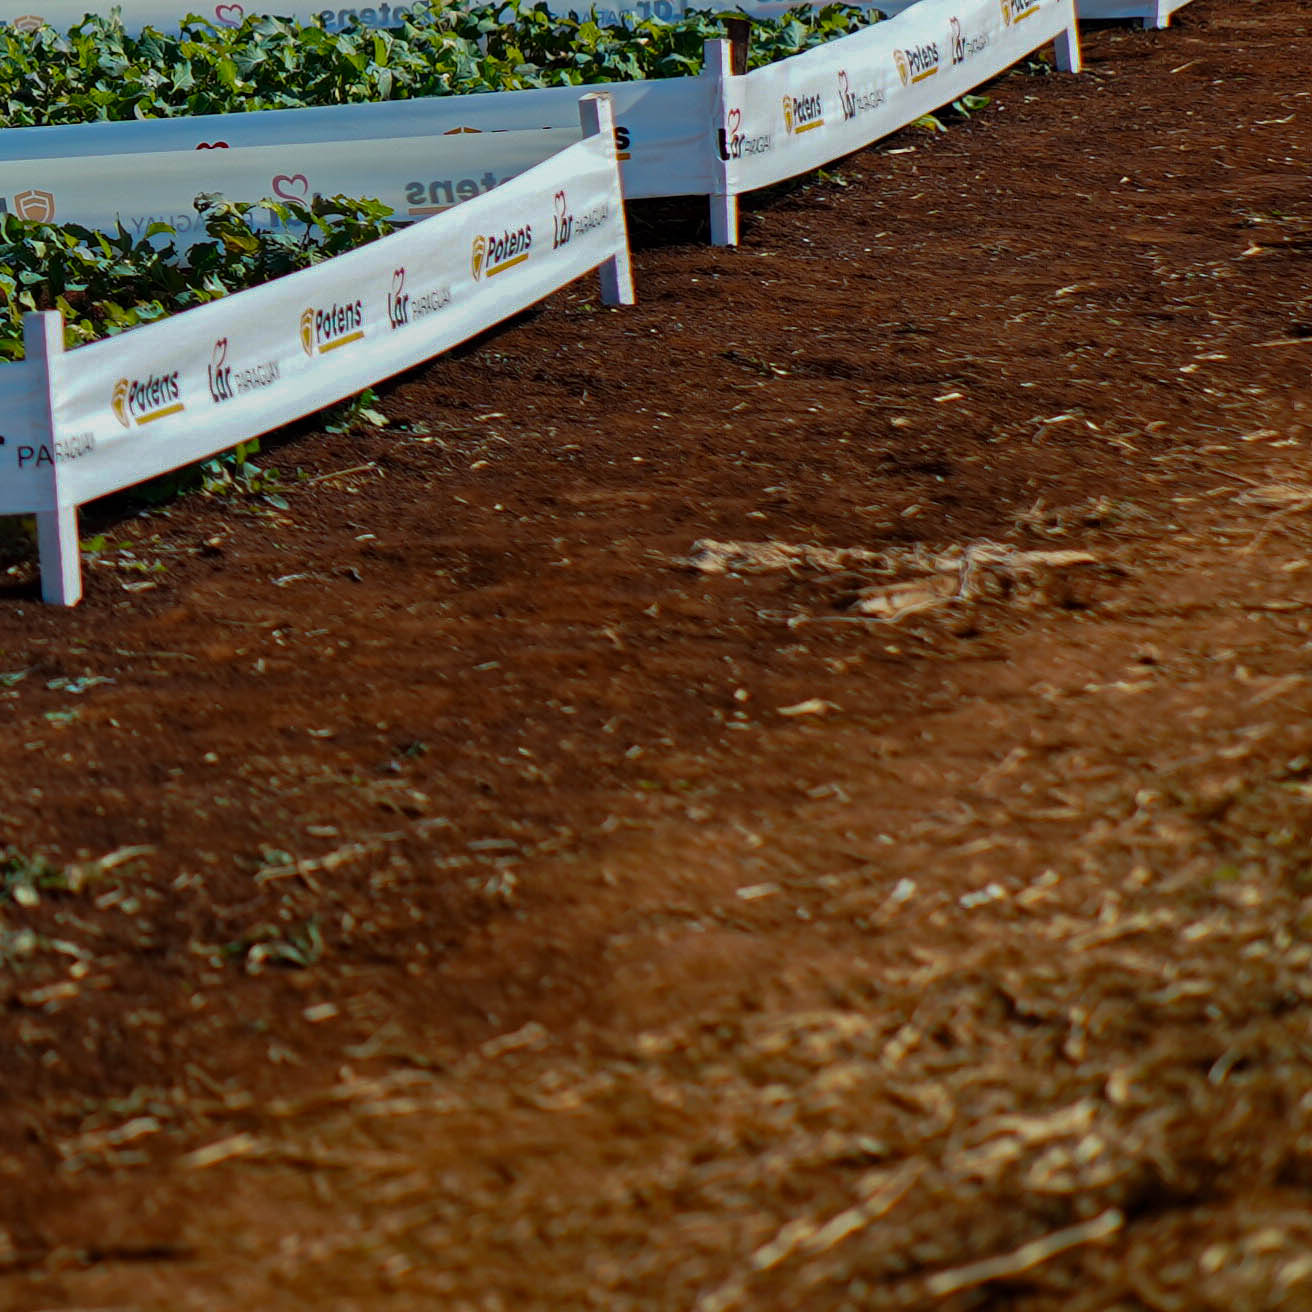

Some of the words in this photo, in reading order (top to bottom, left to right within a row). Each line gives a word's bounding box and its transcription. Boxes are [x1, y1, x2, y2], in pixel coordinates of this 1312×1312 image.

[486, 224, 532, 268] Potens
[554, 214, 572, 250] Lar
[316, 299, 362, 343] Potens
[388, 292, 409, 329] Lar
[128, 369, 179, 416] Potens
[208, 364, 233, 402] Lar
